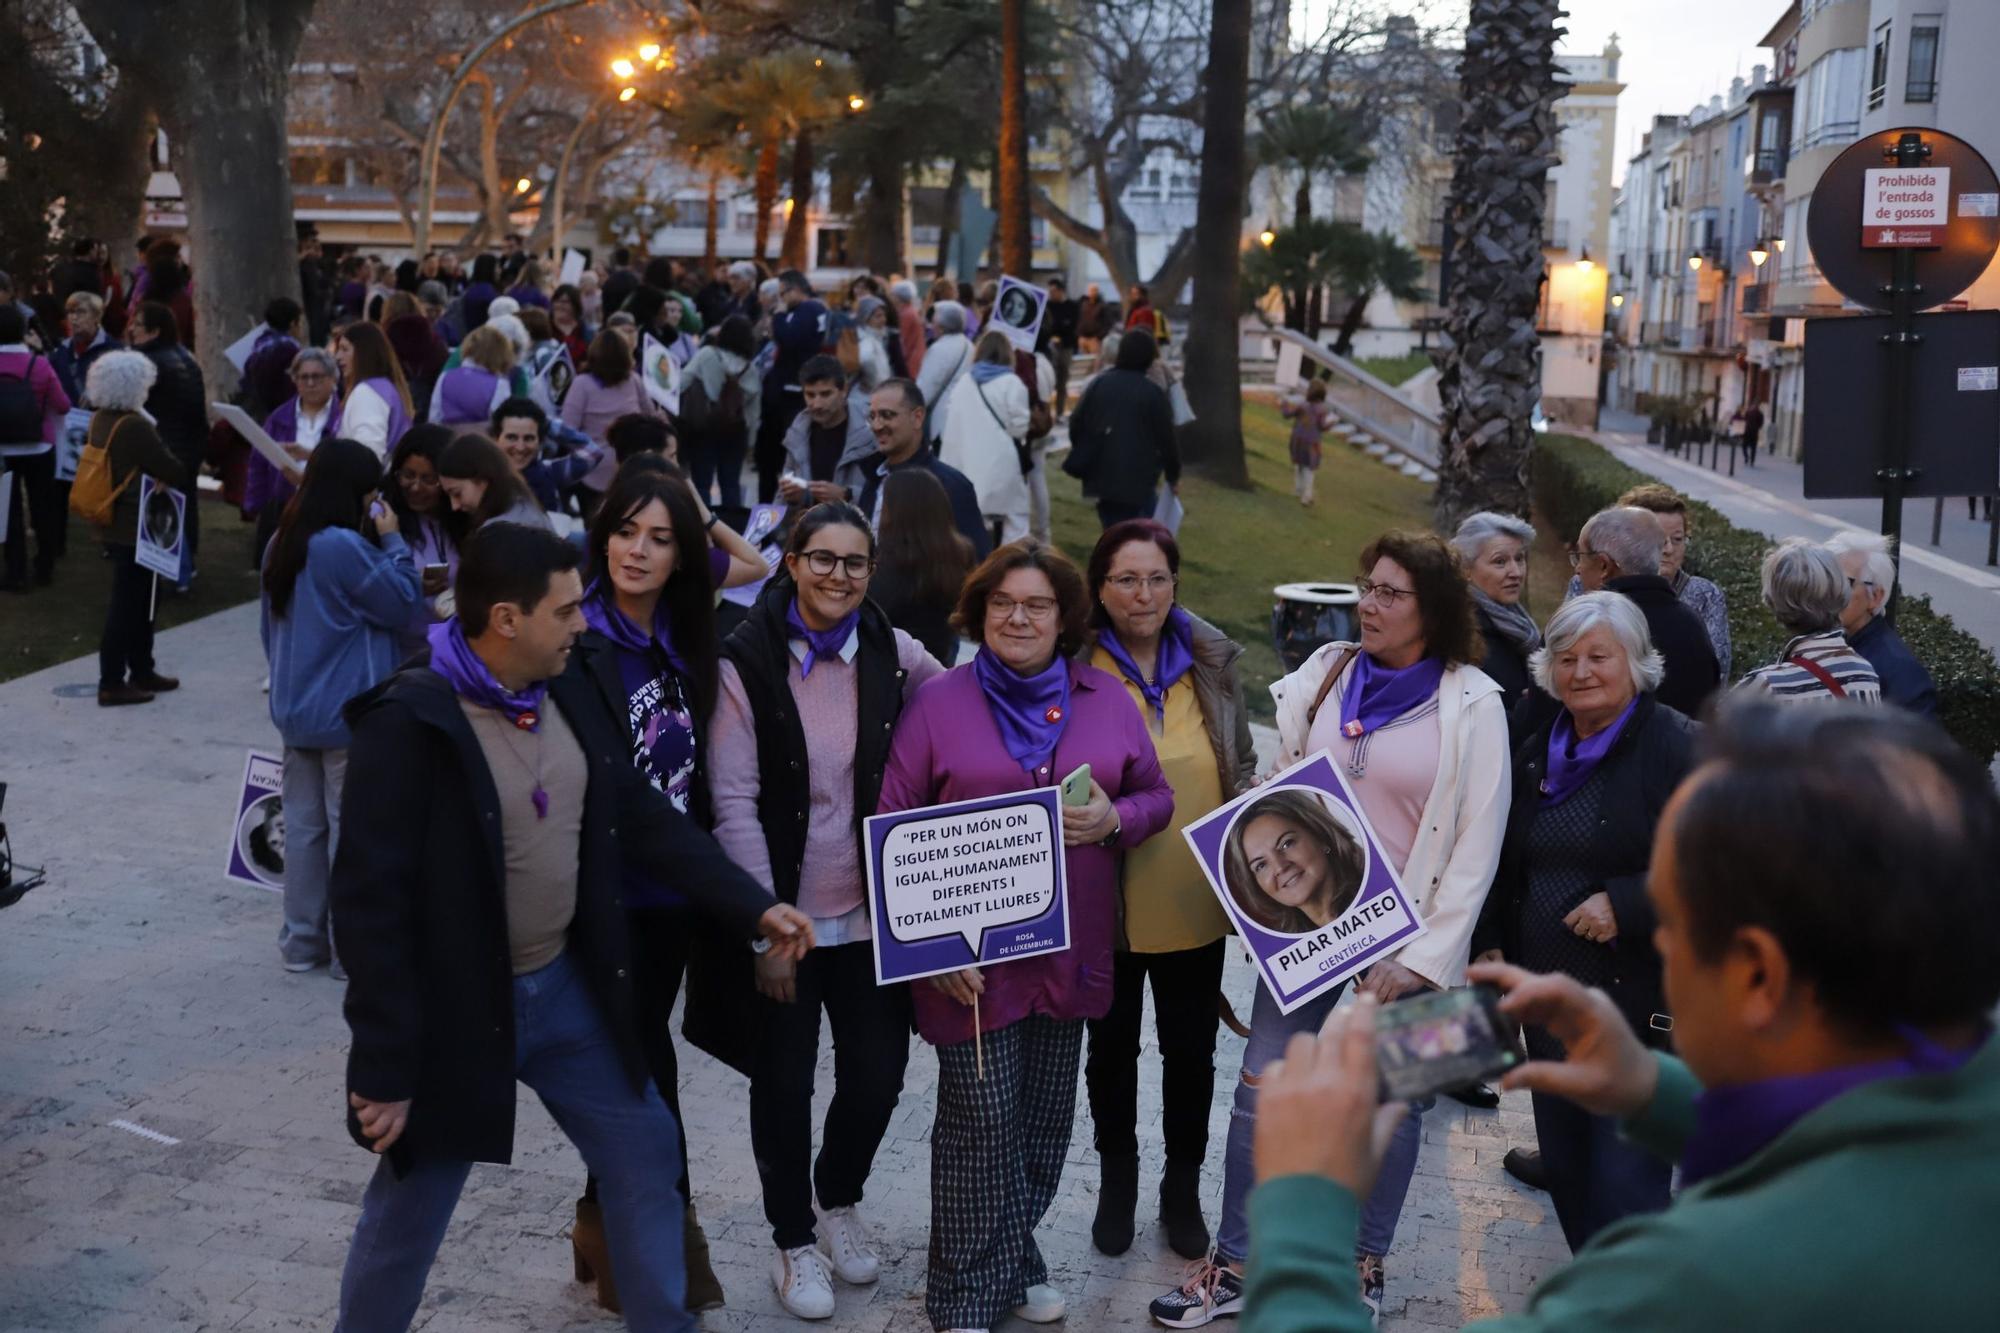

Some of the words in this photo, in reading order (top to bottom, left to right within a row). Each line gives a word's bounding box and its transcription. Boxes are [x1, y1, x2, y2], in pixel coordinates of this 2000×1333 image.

[1878, 174, 1936, 187] Prohibida
[1879, 190, 1934, 203] l'entrada
[1875, 207, 1891, 219] de
[1895, 208, 1935, 221] gossos
[630, 678, 662, 704] JUNTE
[903, 829, 936, 844] "PER
[940, 824, 962, 839] UN
[966, 817, 1001, 835] MÓN
[1005, 813, 1028, 828] ON
[894, 847, 949, 867] SIGUEM
[953, 831, 1043, 857] SOCIALMENT
[932, 879, 1007, 901] DIFERENTS
[1011, 876, 1016, 888] I
[895, 902, 982, 928] TOTALMENT
[1015, 932, 1035, 942] ROSA
[1278, 933, 1333, 971] PILAR
[1332, 895, 1396, 940] MATEO
[999, 946, 1009, 955] DE
[1010, 938, 1054, 953] LUXEMBURG
[1318, 934, 1377, 972] CIENTÍFICA
